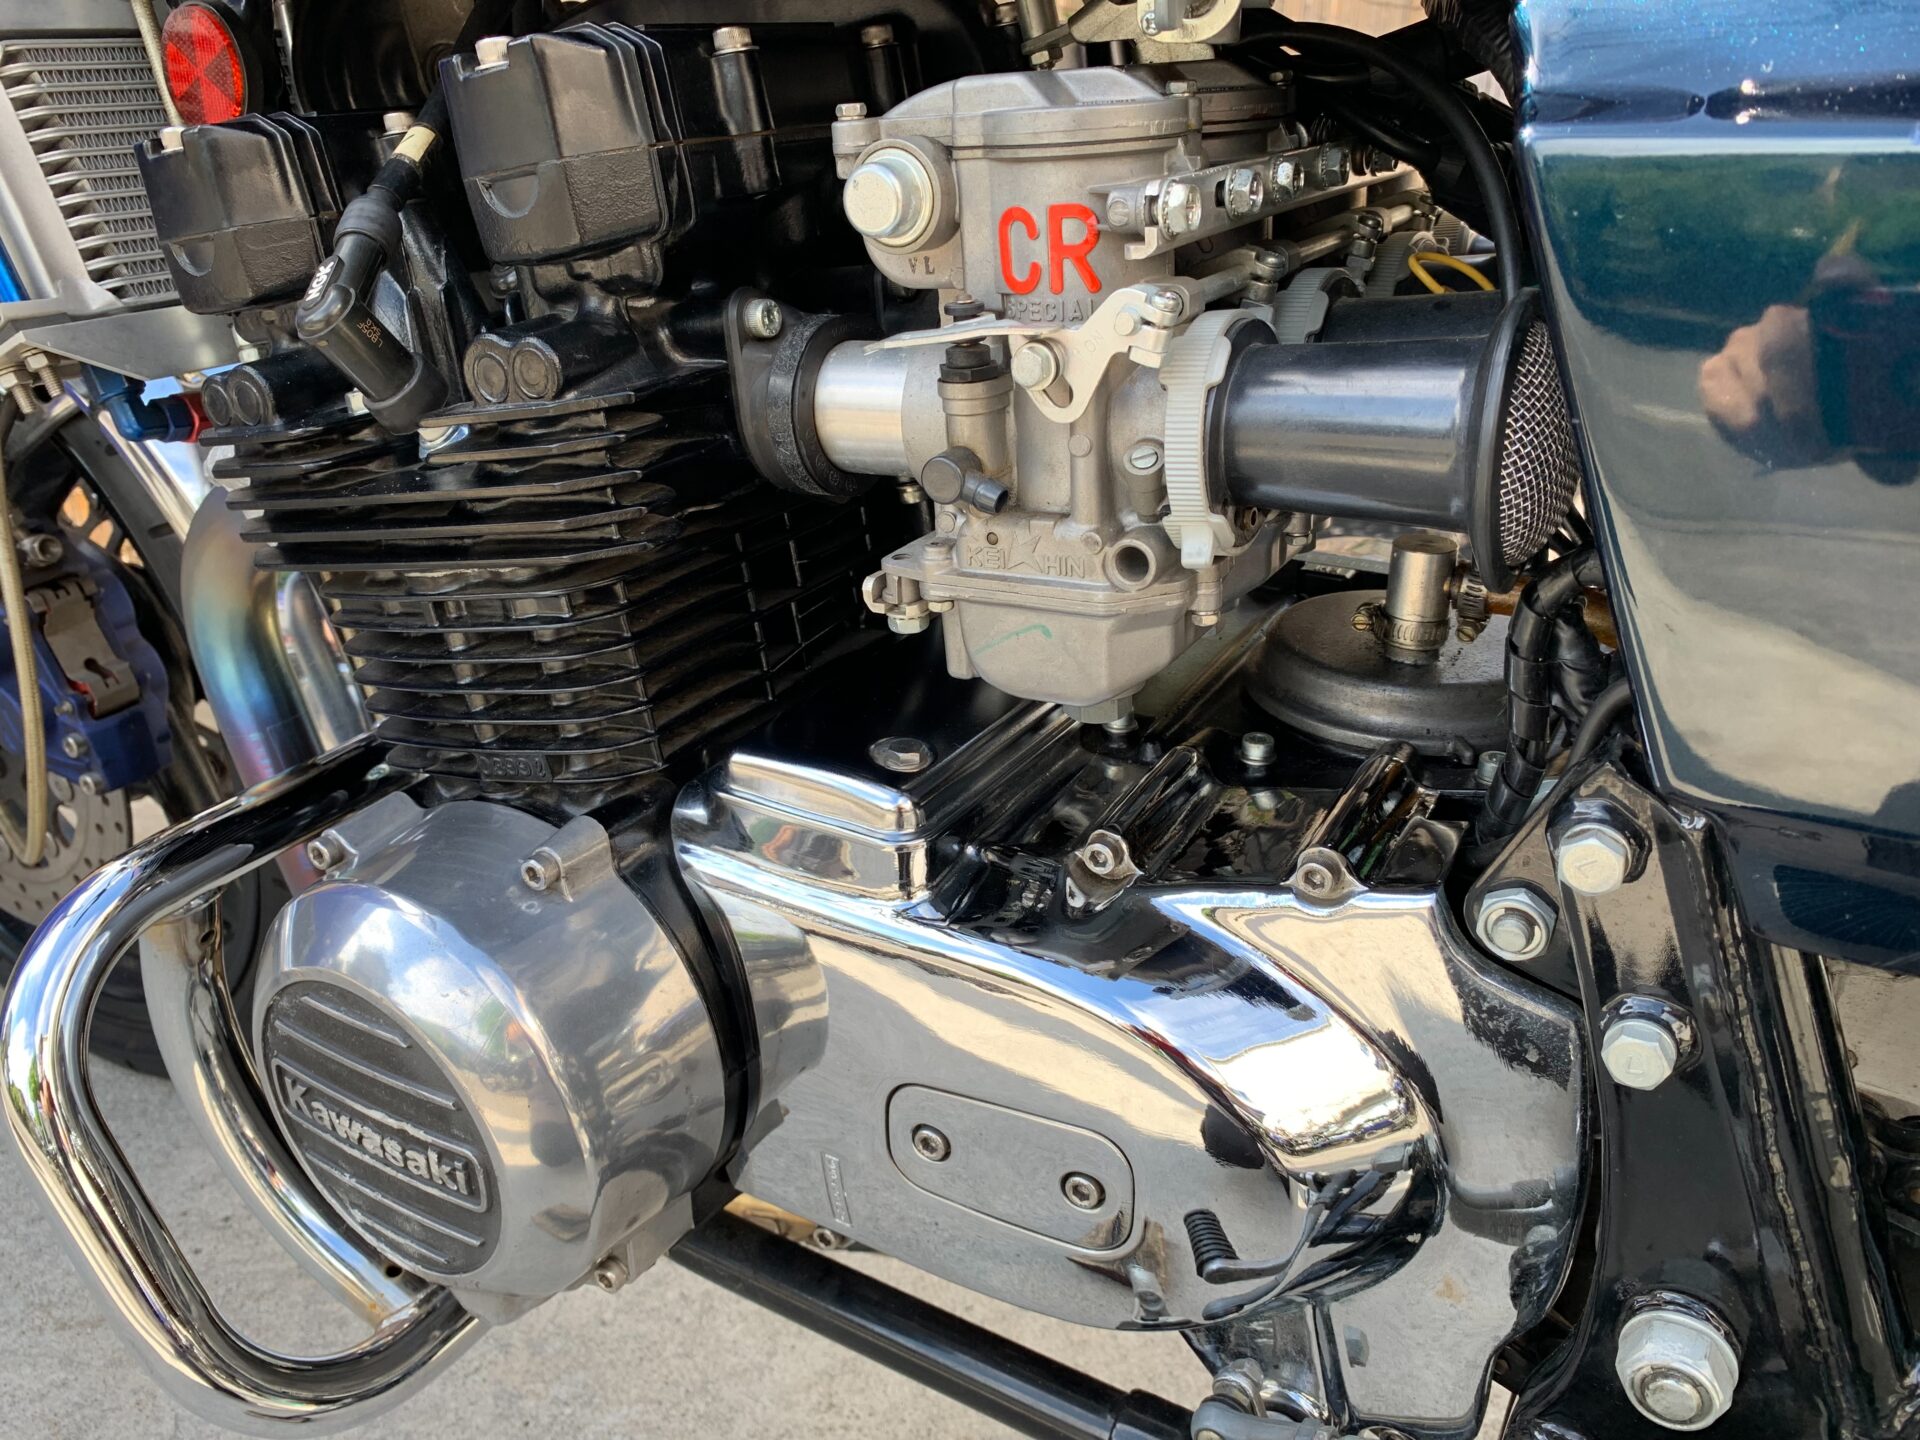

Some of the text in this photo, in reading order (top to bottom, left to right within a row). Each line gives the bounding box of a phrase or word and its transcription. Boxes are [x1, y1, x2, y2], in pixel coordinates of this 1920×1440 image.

[305, 261, 334, 301] NGK
[998, 203, 1102, 295] CR
[284, 1076, 469, 1196] Kawasaki
